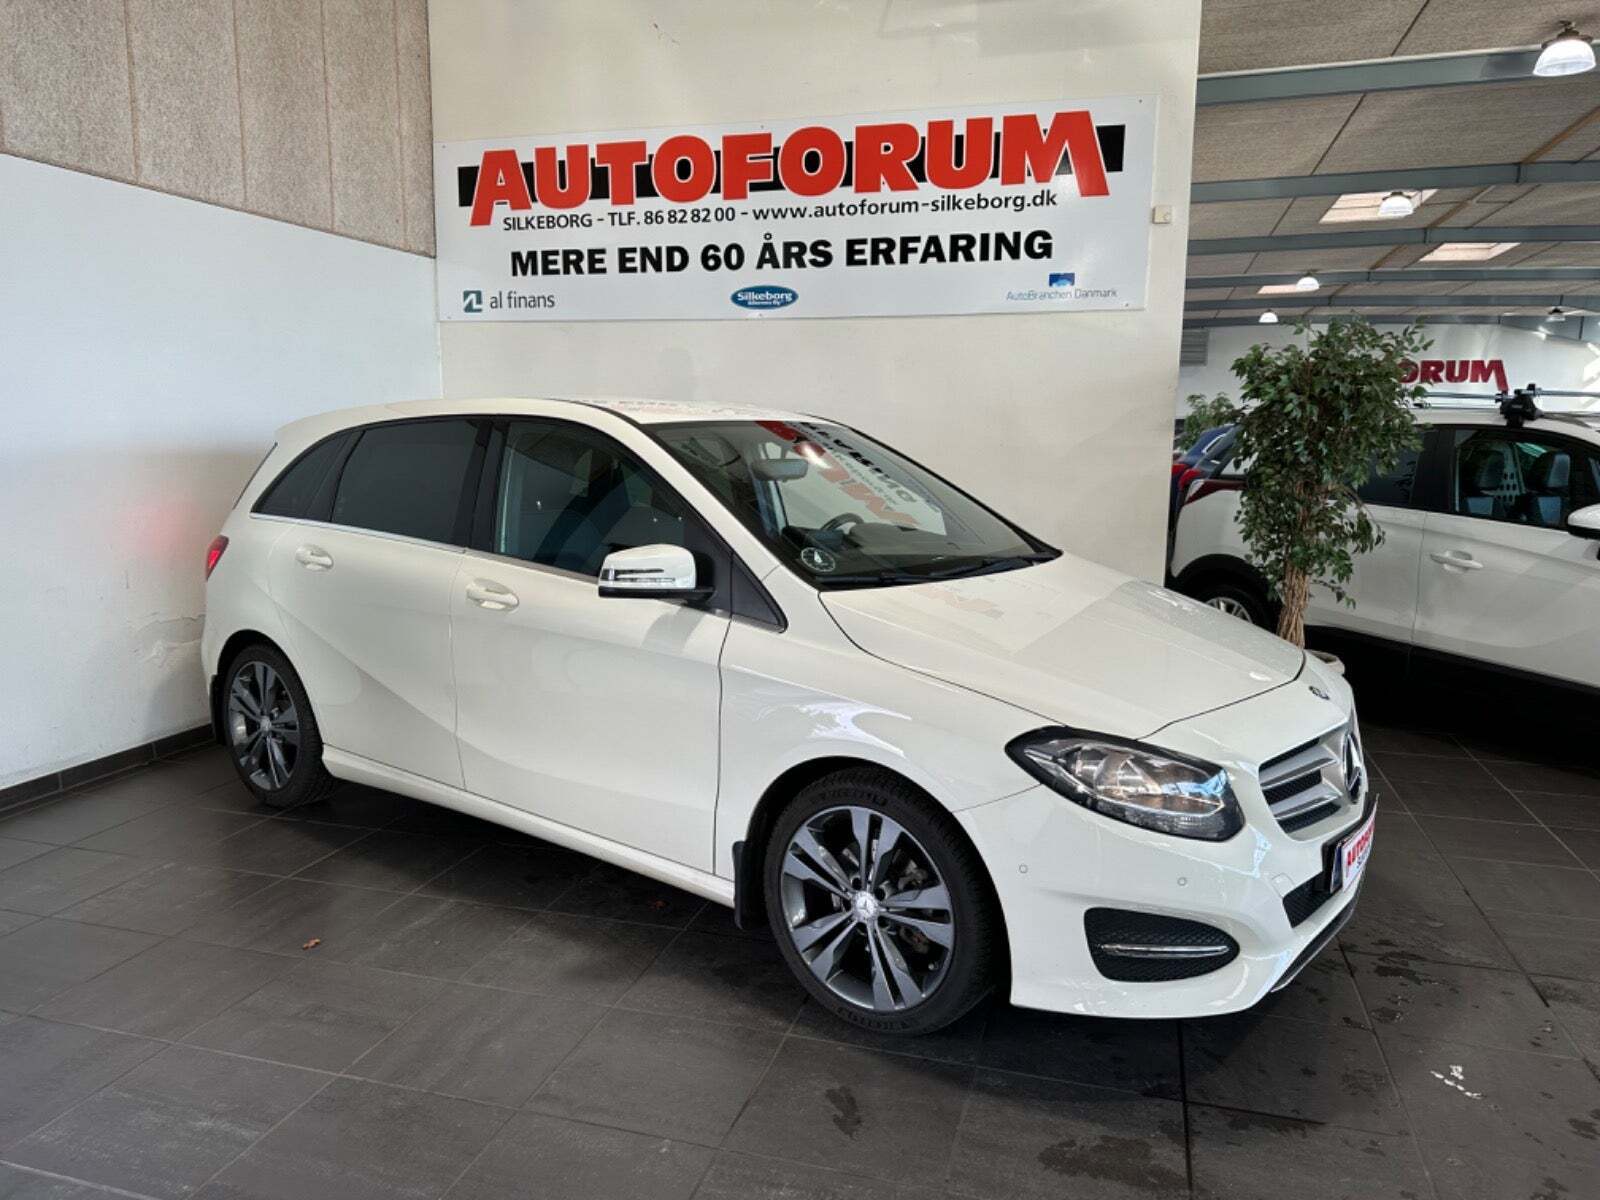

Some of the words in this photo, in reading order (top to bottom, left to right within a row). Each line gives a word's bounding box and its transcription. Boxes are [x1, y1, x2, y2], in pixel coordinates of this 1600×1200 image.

[470, 109, 1110, 227] AUTOFORUM
[503, 213, 593, 231] SILKEBORG
[608, 211, 641, 227] TLF.
[752, 189, 1058, 220] www.autoforum-silkeborg.dk
[510, 247, 608, 277] MERE
[617, 245, 690, 274] END
[700, 242, 745, 272] 60
[755, 232, 834, 270] ÅRS
[845, 229, 1053, 267] ERFARING
[490, 291, 503, 309] al
[507, 290, 556, 309] finans
[737, 291, 793, 302] Silkeborg
[1006, 289, 1073, 301] AutoBranchen
[1074, 287, 1118, 299] Danmark
[1397, 359, 1509, 394] ORUM
